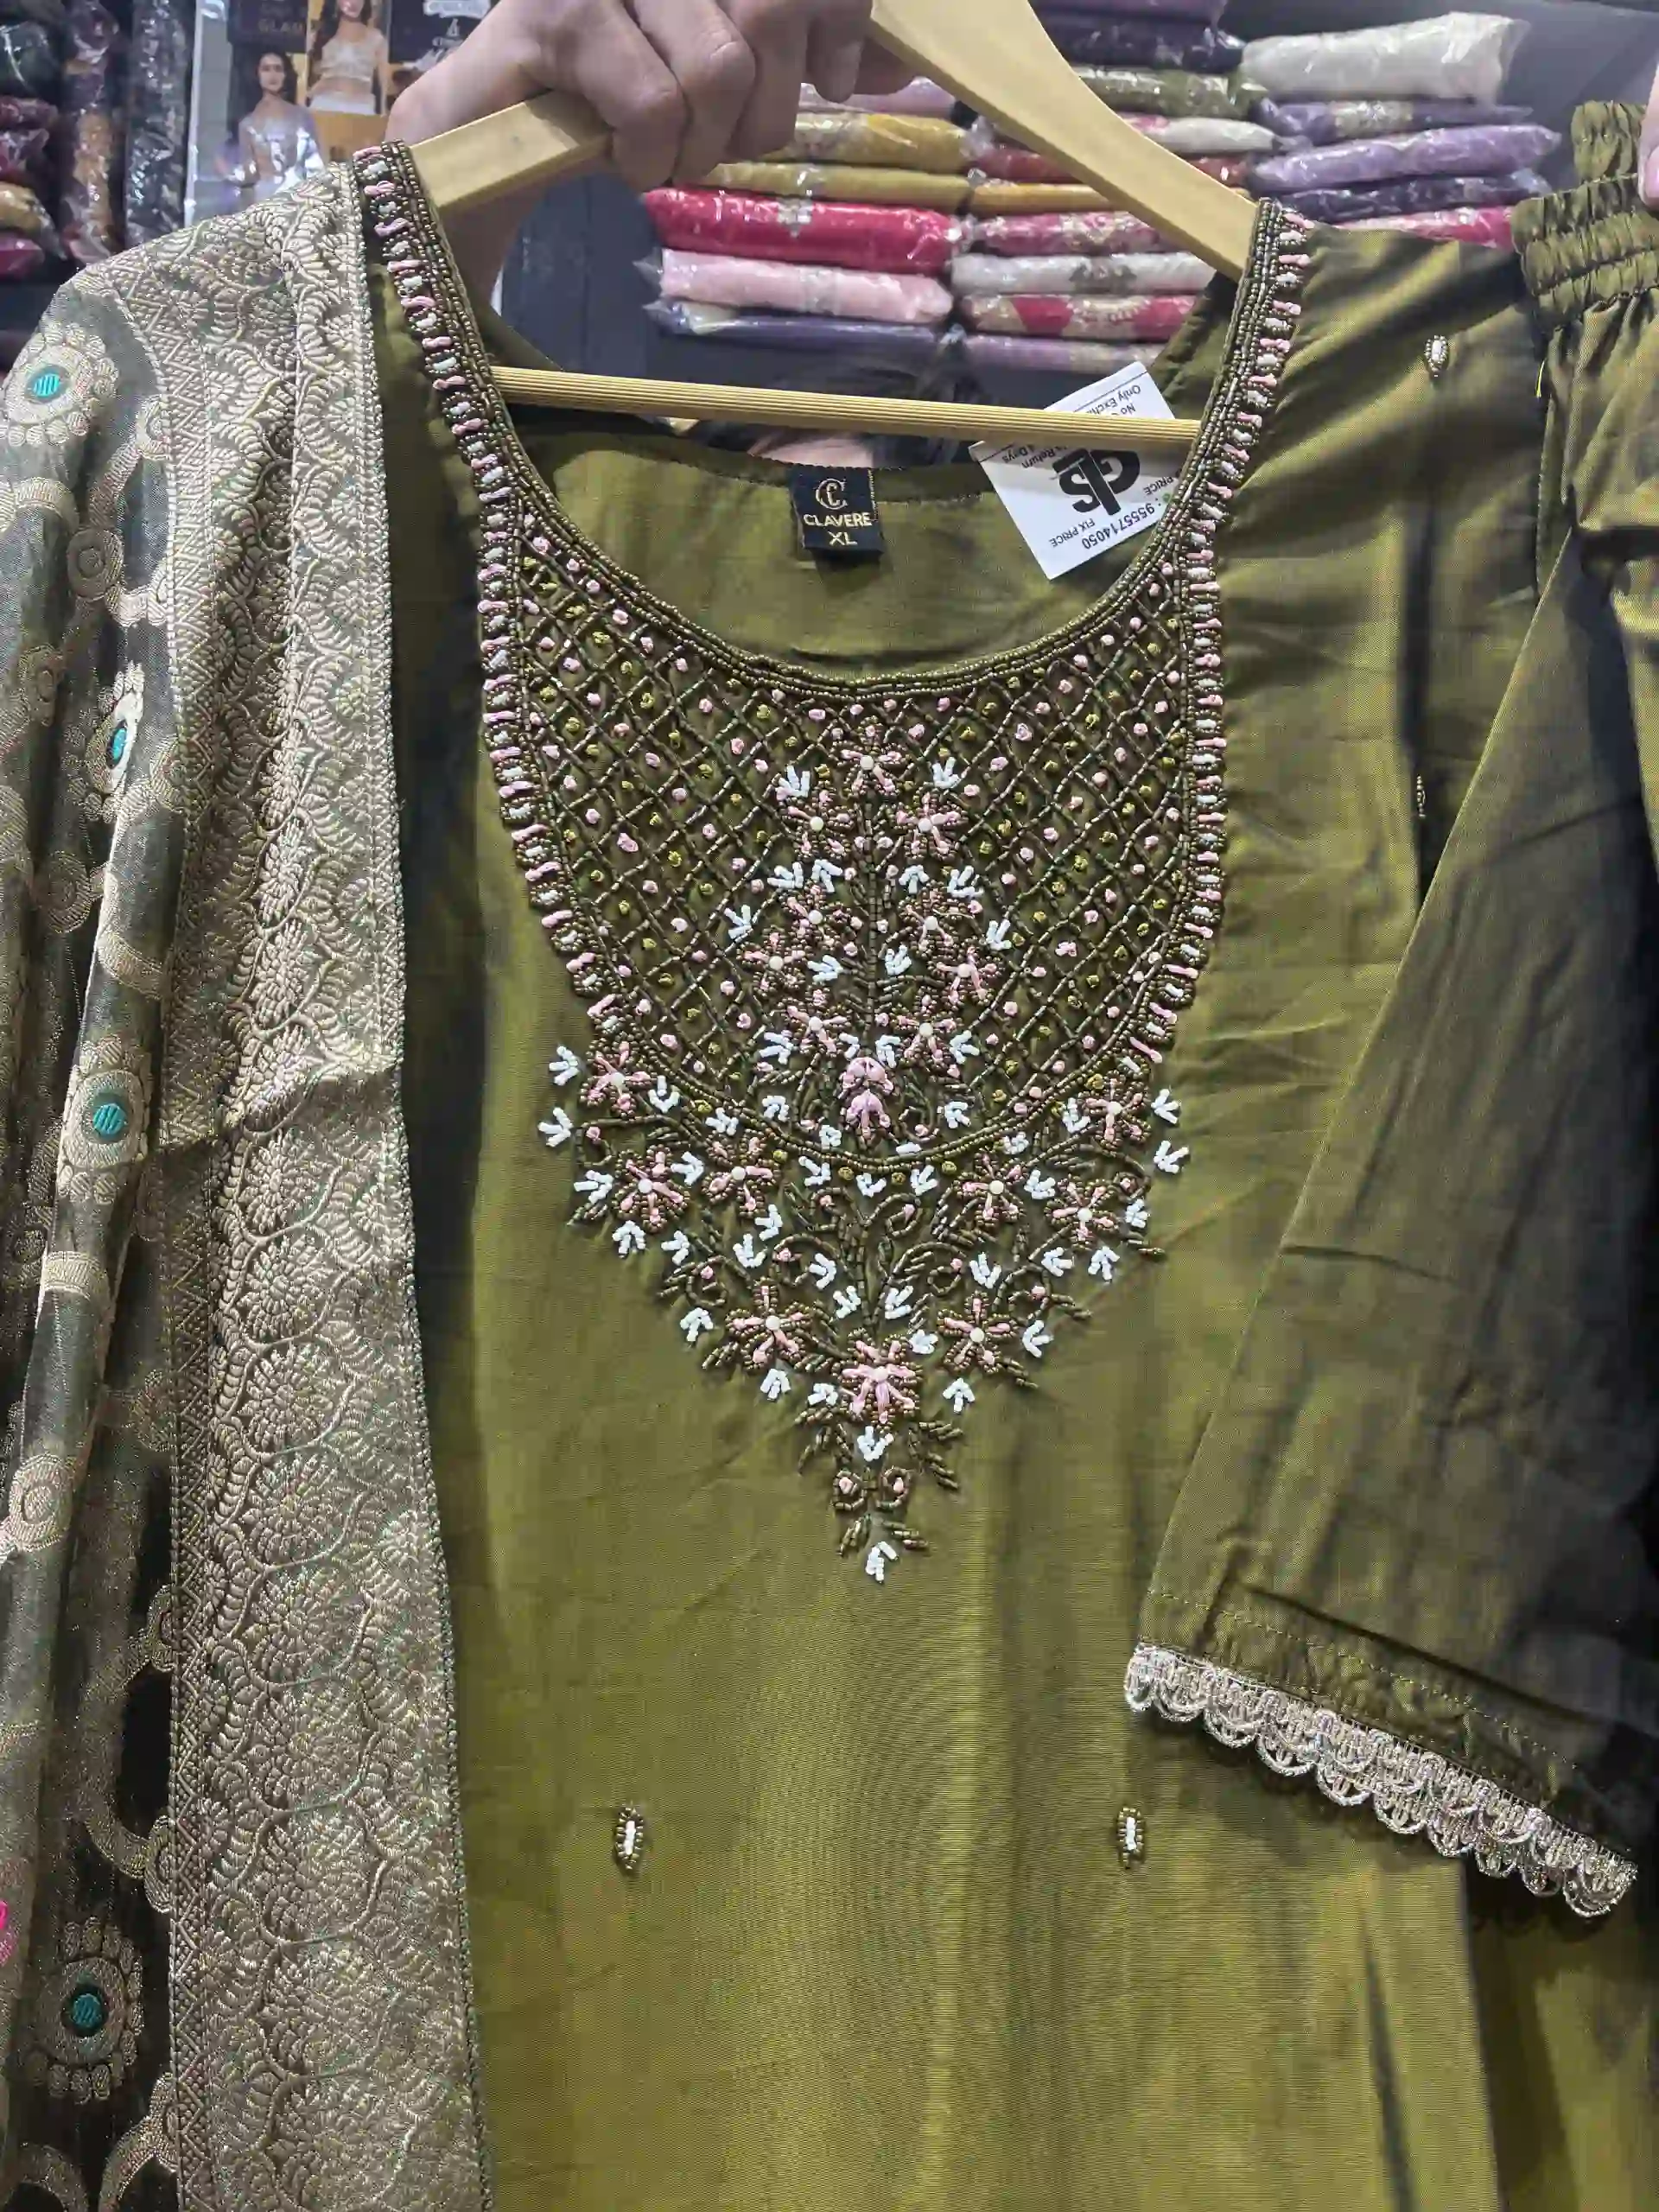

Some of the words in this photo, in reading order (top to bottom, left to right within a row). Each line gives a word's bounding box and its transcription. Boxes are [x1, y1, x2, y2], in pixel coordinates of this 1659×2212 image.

[1117, 385, 1141, 402] Only
[1120, 402, 1136, 416] No
[1142, 476, 1174, 496] PRICE
[803, 512, 873, 527] CLAVERE
[1078, 518, 1096, 532] FIX
[1081, 502, 1155, 550] 9555714050
[827, 530, 858, 546] XL
[1048, 528, 1079, 548] PRICE
